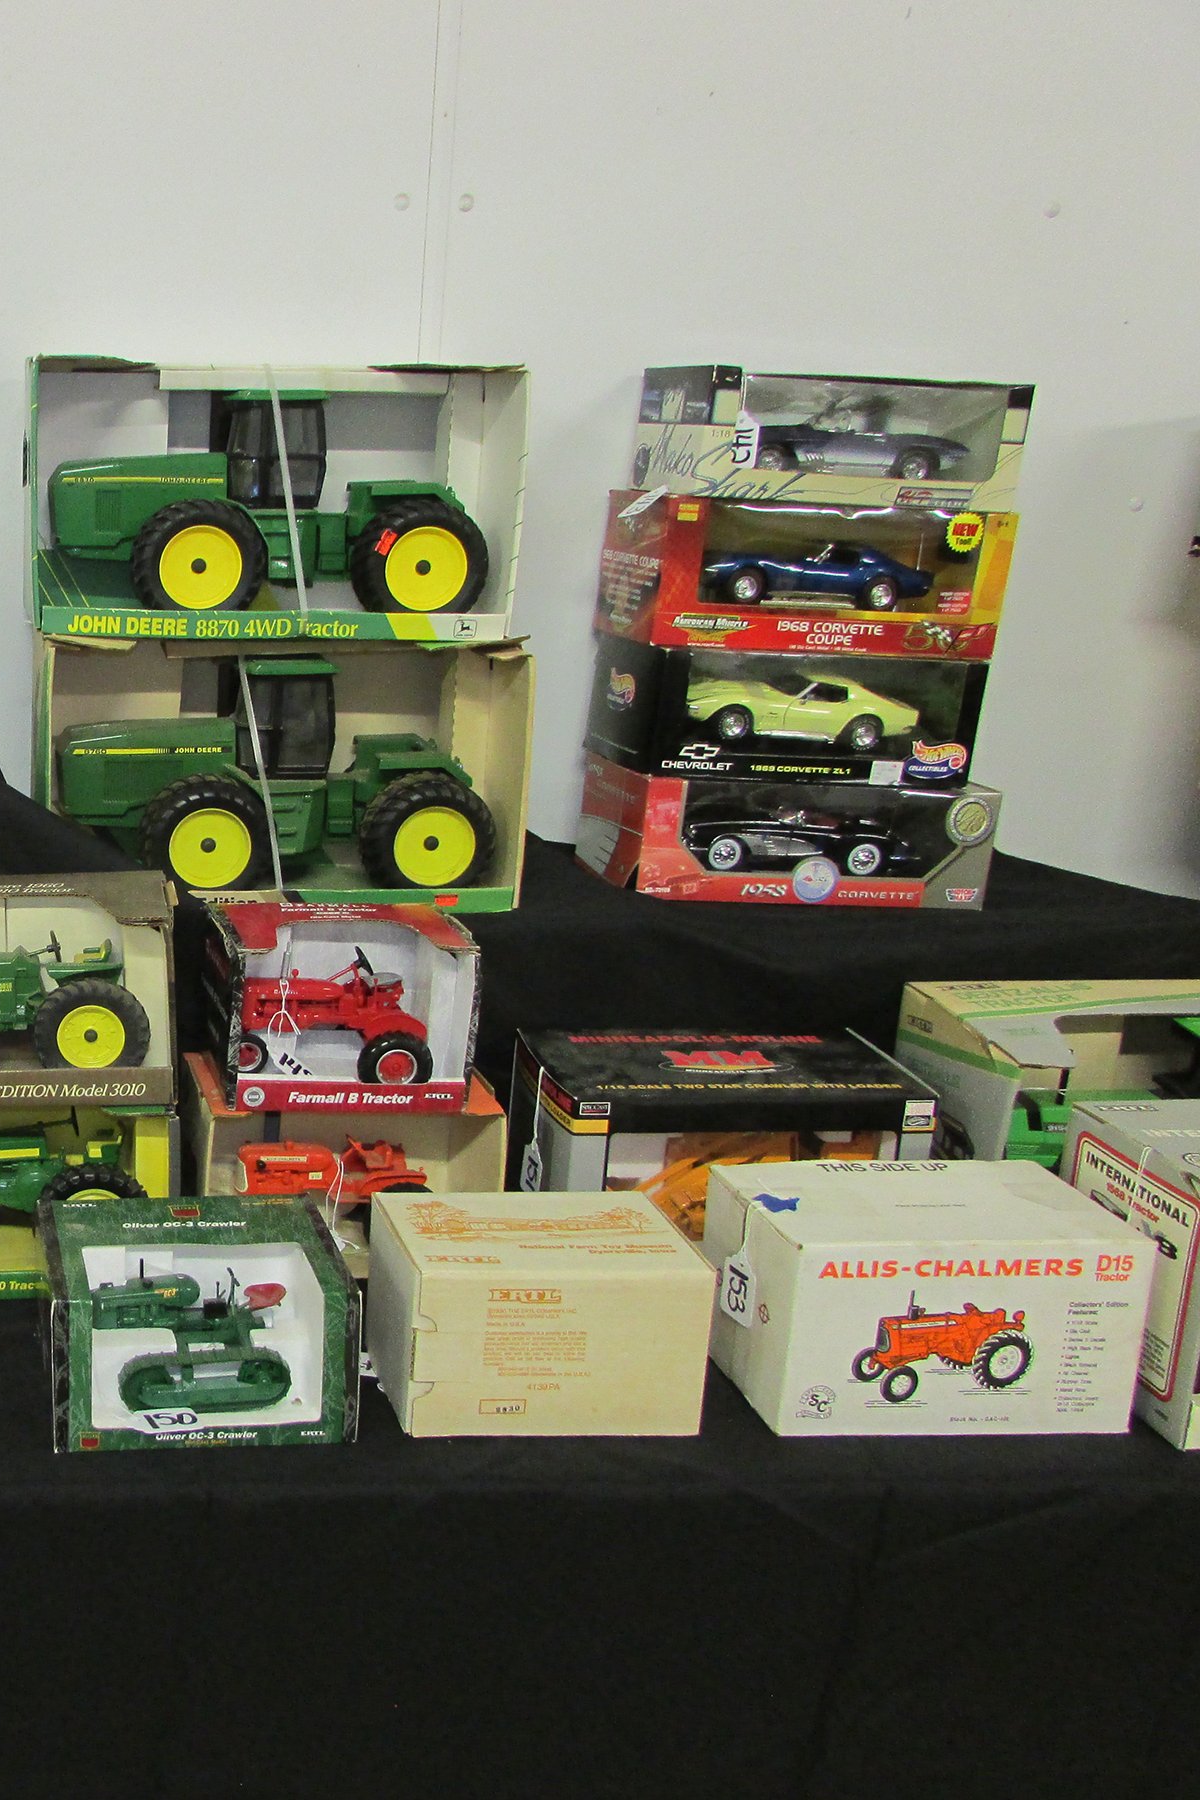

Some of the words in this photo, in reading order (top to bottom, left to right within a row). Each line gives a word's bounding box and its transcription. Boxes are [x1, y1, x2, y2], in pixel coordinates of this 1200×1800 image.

[67, 615, 122, 635] JOHN
[126, 617, 188, 637] DEERE
[195, 619, 240, 638] 8870
[244, 618, 292, 638] 4WD
[297, 618, 359, 638] Tractor
[776, 620, 809, 632] 1968
[813, 621, 885, 636] CORVETTE
[806, 633, 853, 646] COUPE
[661, 759, 734, 772] CHEVROLET
[749, 764, 776, 773] 1969
[776, 765, 831, 775] CORVETTE
[832, 767, 852, 776] ZL1
[739, 883, 788, 898] 1958
[836, 890, 918, 901] CORVETTE
[567, 1035, 825, 1044] MINNEAPOLIS-MOLINE
[61, 1083, 111, 1098] Model
[110, 1082, 147, 1097] 3010
[626, 1083, 672, 1091] SCALE
[673, 1083, 705, 1091] TWO
[744, 1082, 810, 1090] CRAWLER
[811, 1082, 847, 1090] WITH
[847, 1082, 904, 1090] LOADER
[288, 1091, 343, 1104] Farmall
[347, 1093, 359, 1104] B
[361, 1092, 414, 1105] Tractor
[816, 1162, 868, 1173] THIS
[869, 1162, 921, 1172] SIDE
[920, 1162, 949, 1172] UP
[122, 1221, 160, 1229] Oliver
[162, 1220, 195, 1229] OC-3
[197, 1219, 247, 1229] Crawler
[817, 1257, 1085, 1280] ALLIS-CHALMERS
[1096, 1254, 1135, 1273] D15
[1094, 1272, 1131, 1283] Tractor
[8, 1280, 37, 1291] Trac
[727, 1264, 750, 1313] 153
[487, 1287, 562, 1305] ERTL
[141, 1412, 199, 1430] 150
[155, 1432, 187, 1441] Oliver
[188, 1431, 215, 1441] OC-3
[216, 1430, 258, 1440] Crawler
